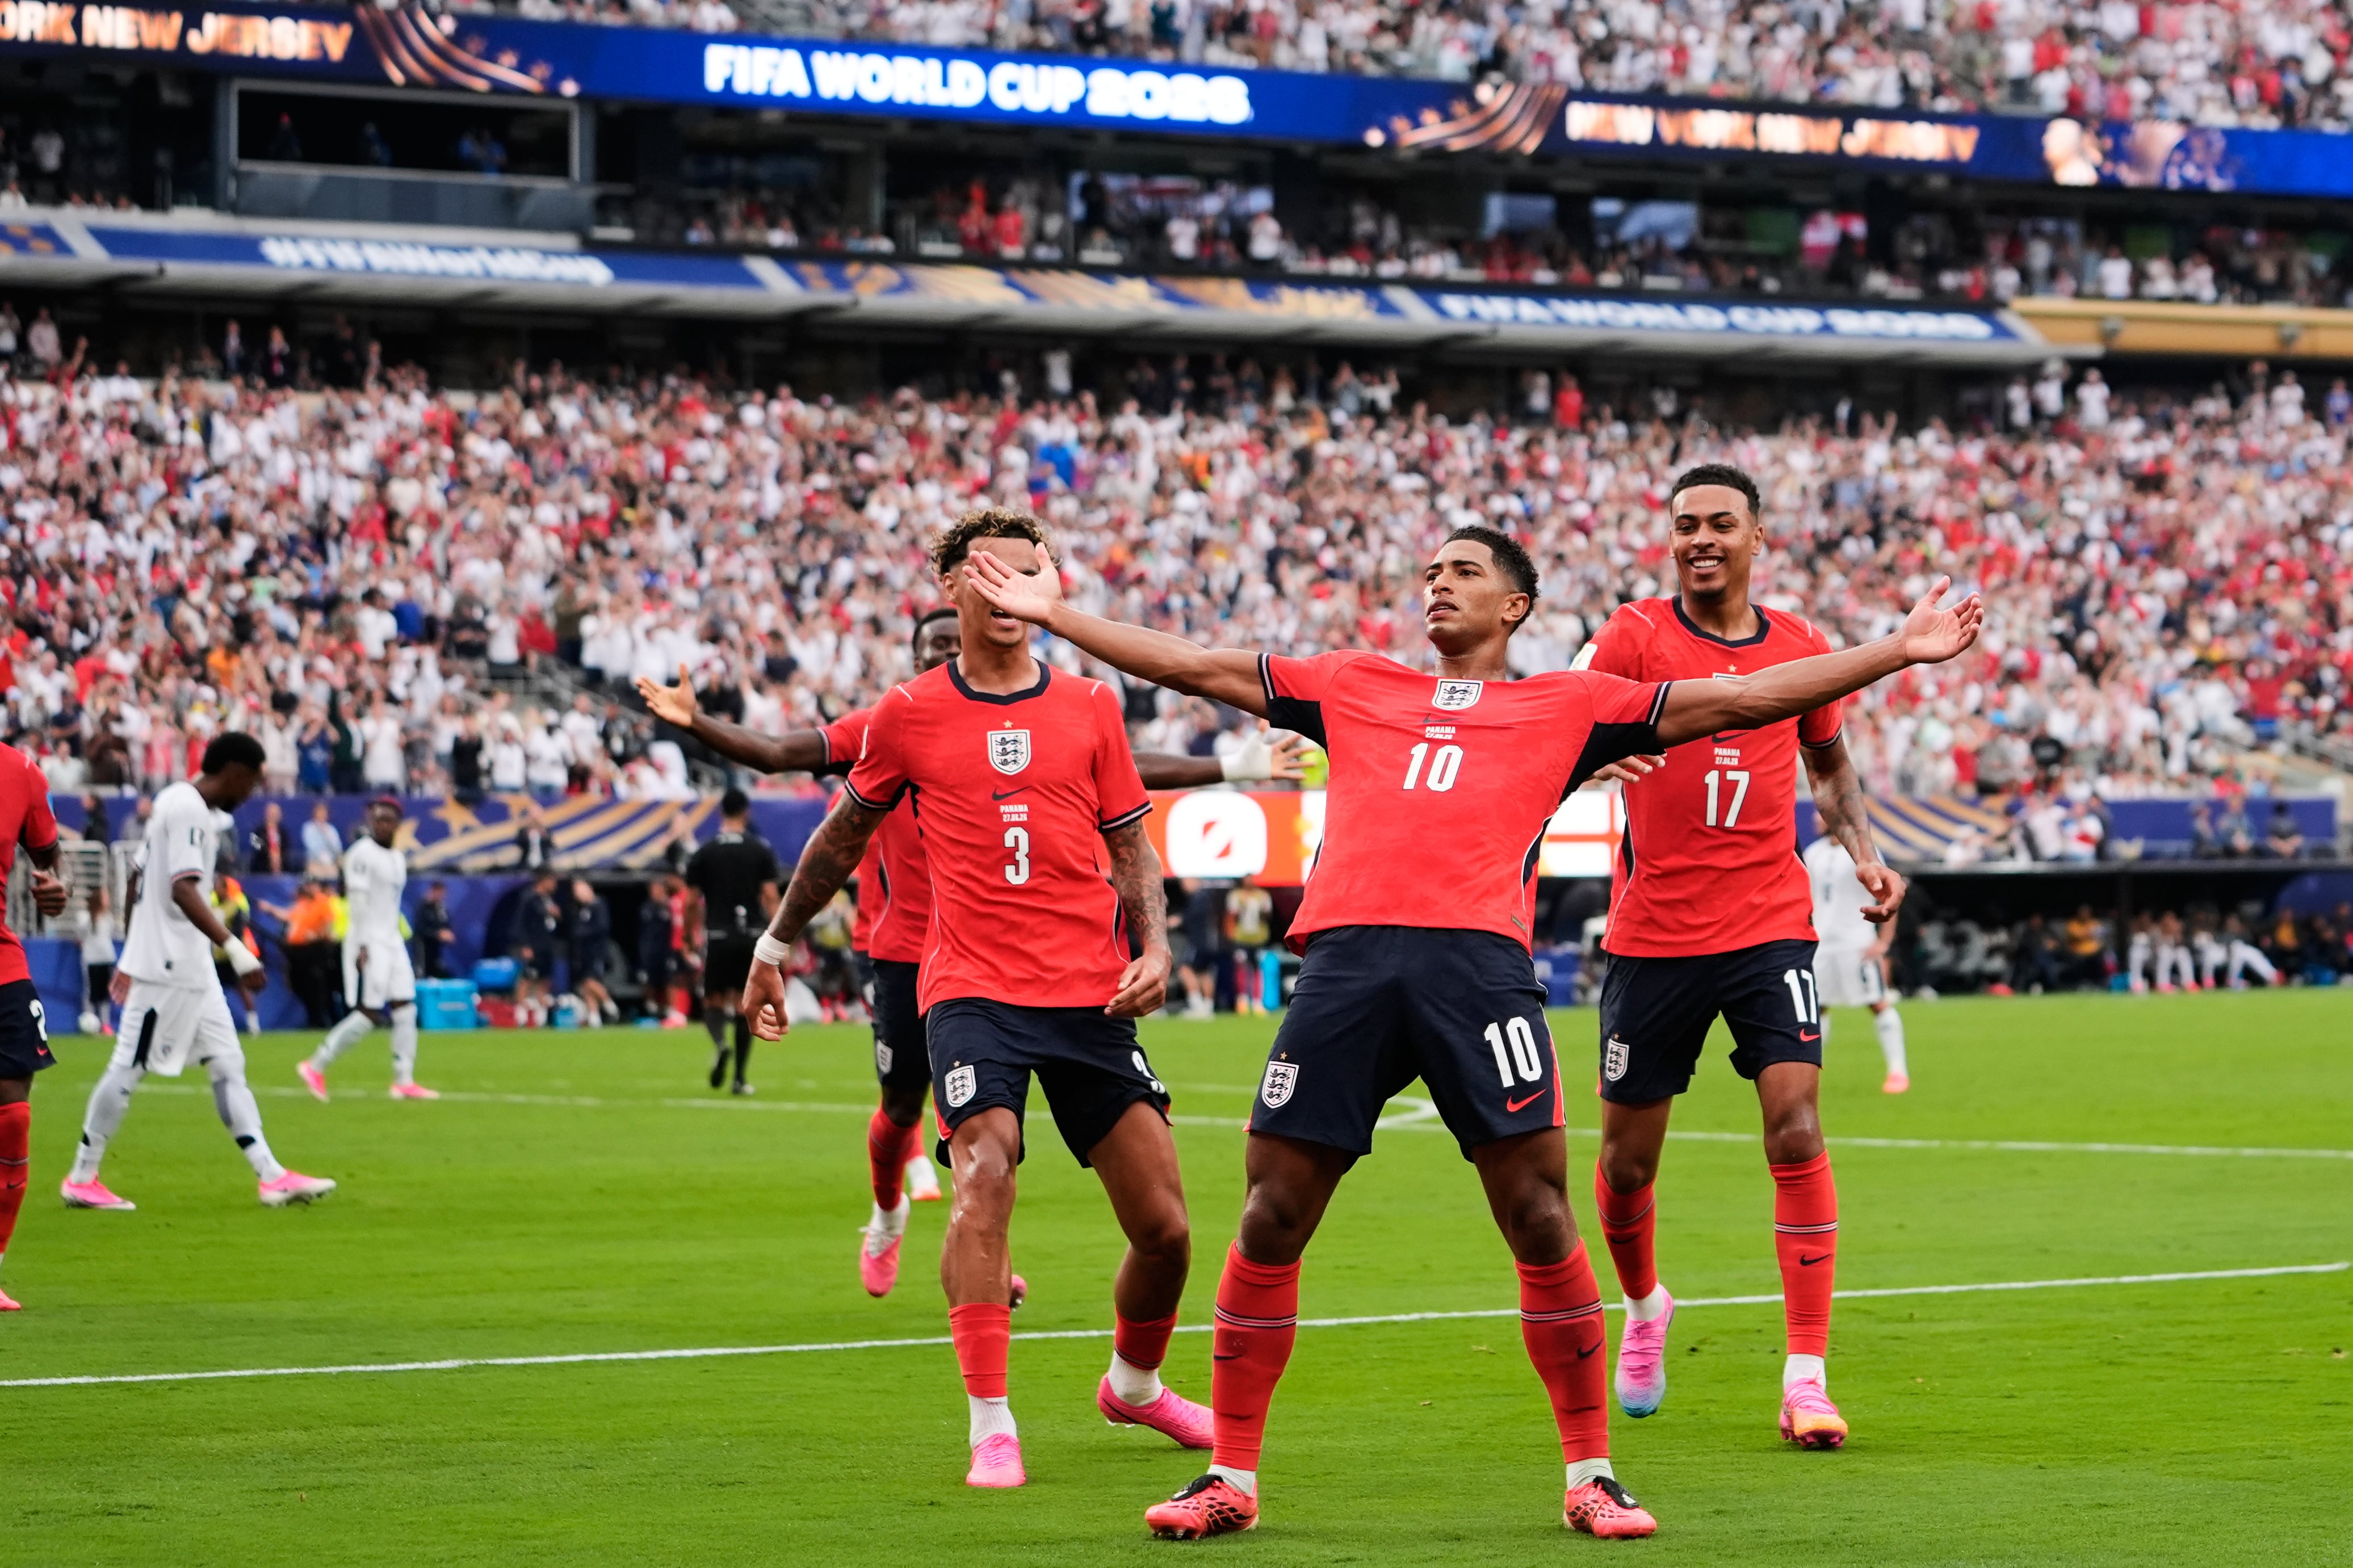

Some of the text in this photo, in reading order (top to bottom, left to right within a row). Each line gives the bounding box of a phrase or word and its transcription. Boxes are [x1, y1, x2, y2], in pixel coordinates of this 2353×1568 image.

[81, 5, 183, 51] NEW
[186, 11, 353, 62] JERSEY
[703, 43, 1253, 124] FIFA WORLD CUP 2026
[1565, 101, 1654, 145] NEW
[1758, 113, 1843, 154] NEW
[1841, 117, 1979, 162] JERSEY
[1437, 293, 1553, 325] FIFA
[1549, 300, 1729, 333] WORLD
[1727, 305, 1823, 334] CUP
[1402, 742, 1465, 793] 10
[1714, 747, 1740, 757] PANAMA
[1000, 804, 1029, 813] PANAMA
[1704, 769, 1750, 828] 17
[1004, 826, 1030, 885] 3
[1783, 969, 1818, 1024] 17
[1483, 1016, 1542, 1088] 10
